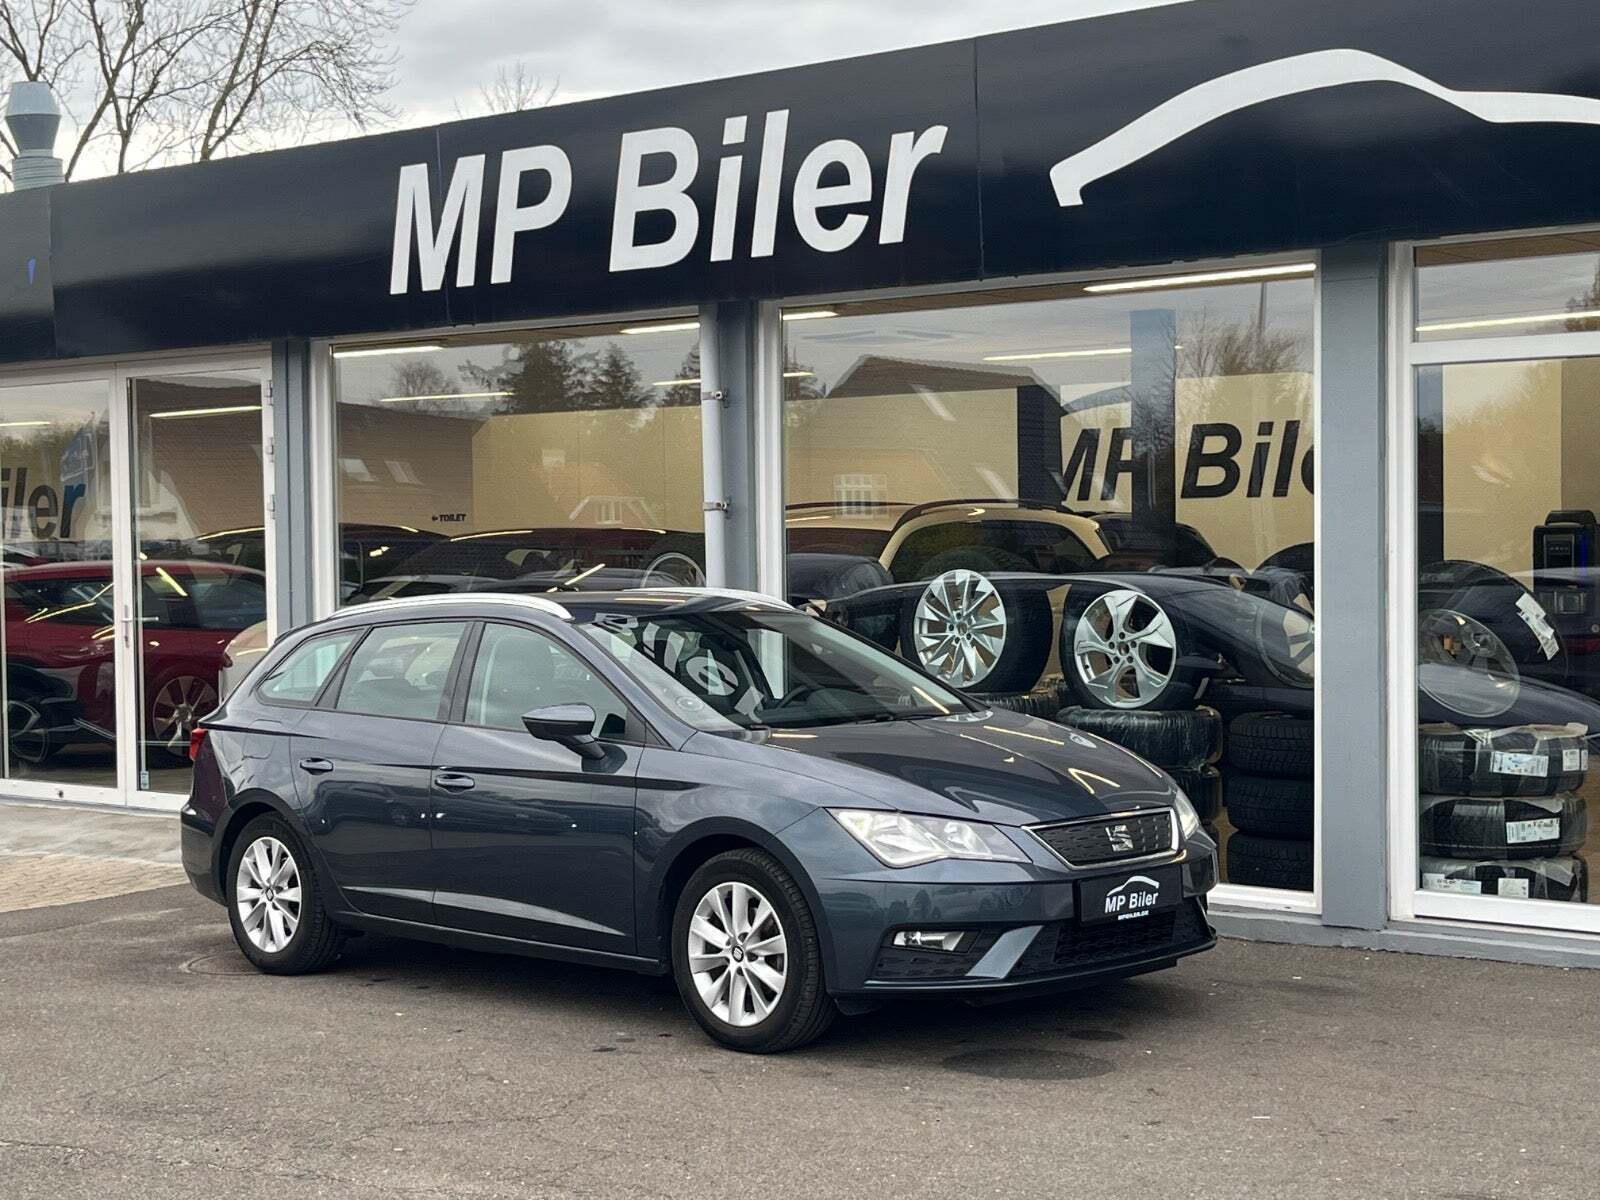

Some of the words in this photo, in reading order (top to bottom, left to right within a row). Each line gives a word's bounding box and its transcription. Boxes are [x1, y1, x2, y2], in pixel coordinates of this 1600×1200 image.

[390, 144, 572, 295] MP
[608, 108, 949, 272] Biler
[1181, 420, 1314, 499] Bil
[439, 513, 467, 522] TOILET
[1104, 895, 1126, 914] MP
[1129, 891, 1159, 909] Biler
